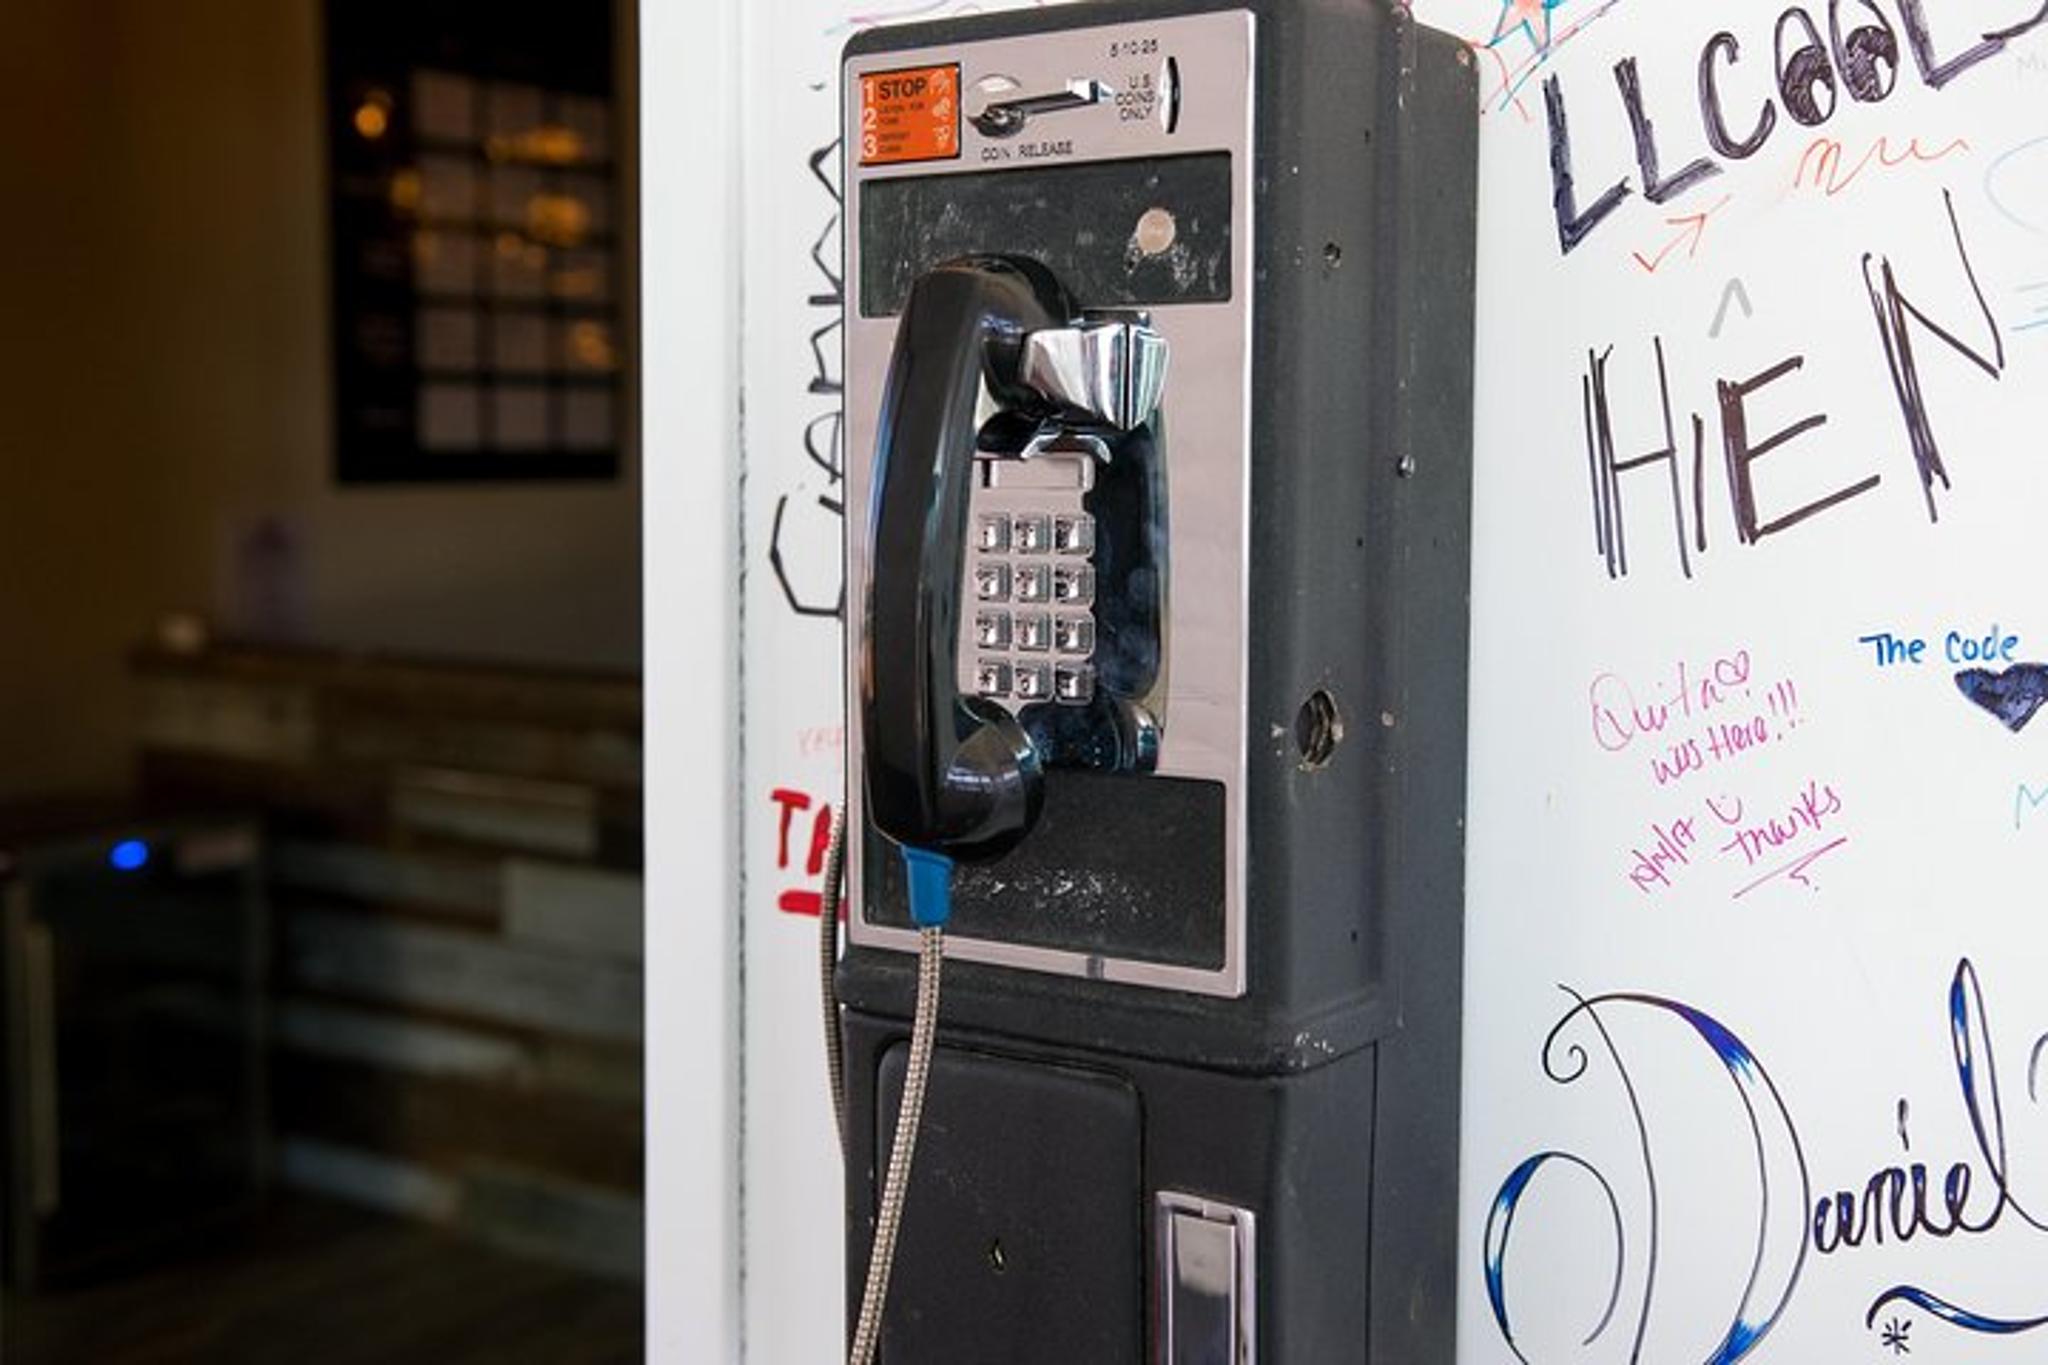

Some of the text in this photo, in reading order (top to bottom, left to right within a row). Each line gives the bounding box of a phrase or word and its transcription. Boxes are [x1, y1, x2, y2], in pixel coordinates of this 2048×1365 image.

[878, 76, 928, 100] STOP
[1114, 89, 1156, 107] COINS
[864, 107, 877, 130] 2
[1119, 103, 1153, 121] ONLY
[864, 133, 877, 158] 3
[981, 140, 1074, 163] COIN RELEASE
[1858, 623, 2019, 667] The Code
